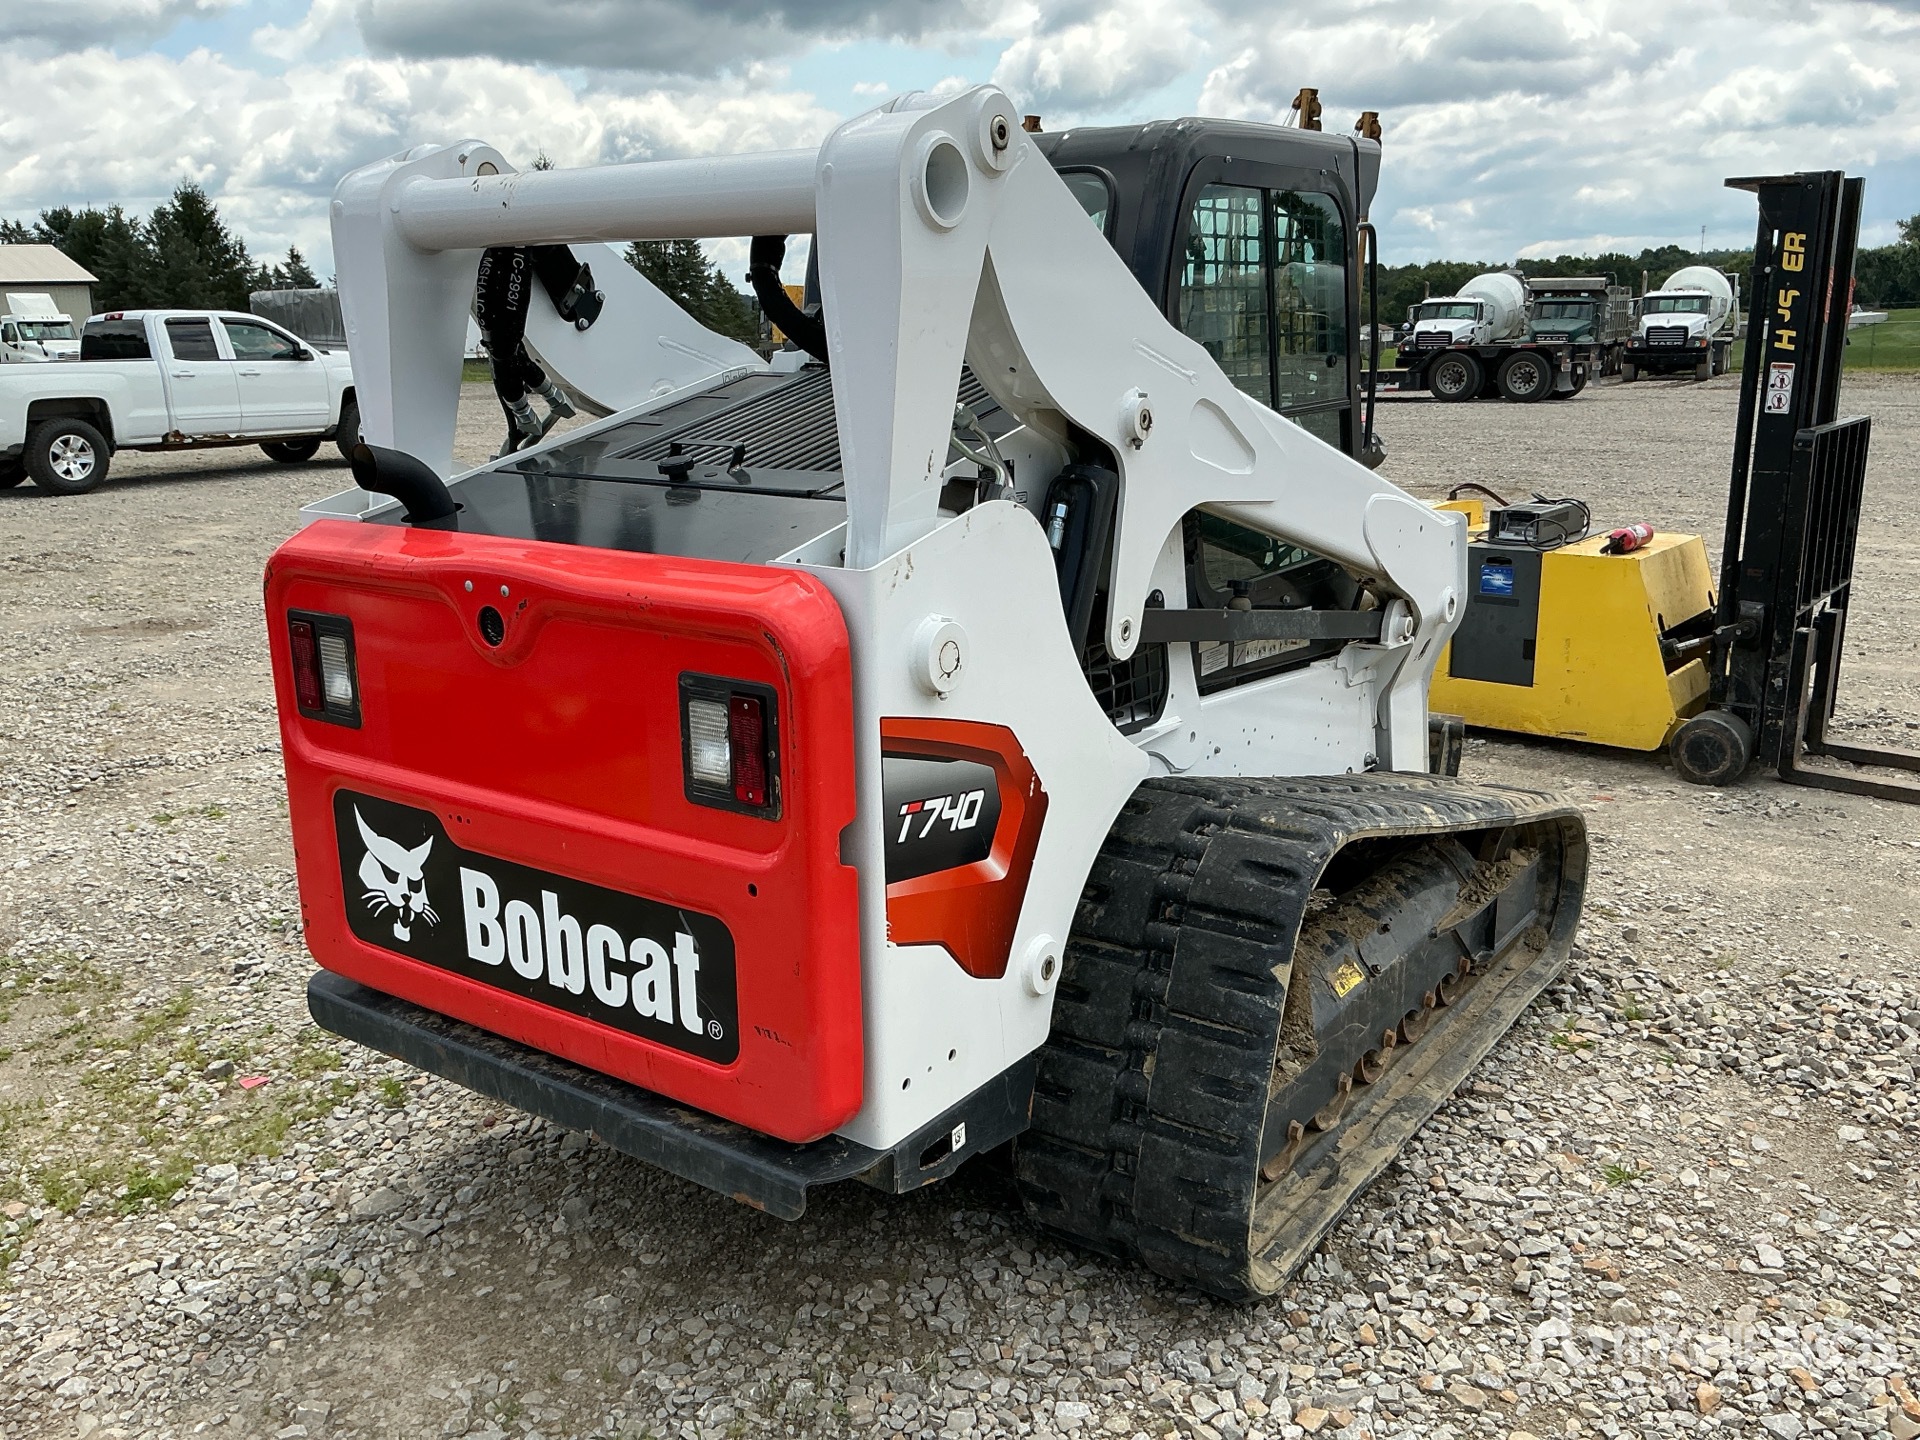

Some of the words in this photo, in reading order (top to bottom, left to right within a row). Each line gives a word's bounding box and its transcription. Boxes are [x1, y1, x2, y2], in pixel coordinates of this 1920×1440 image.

[476, 256, 493, 295] MSHA
[897, 789, 985, 844] T740
[459, 865, 705, 1036] Bobcat
